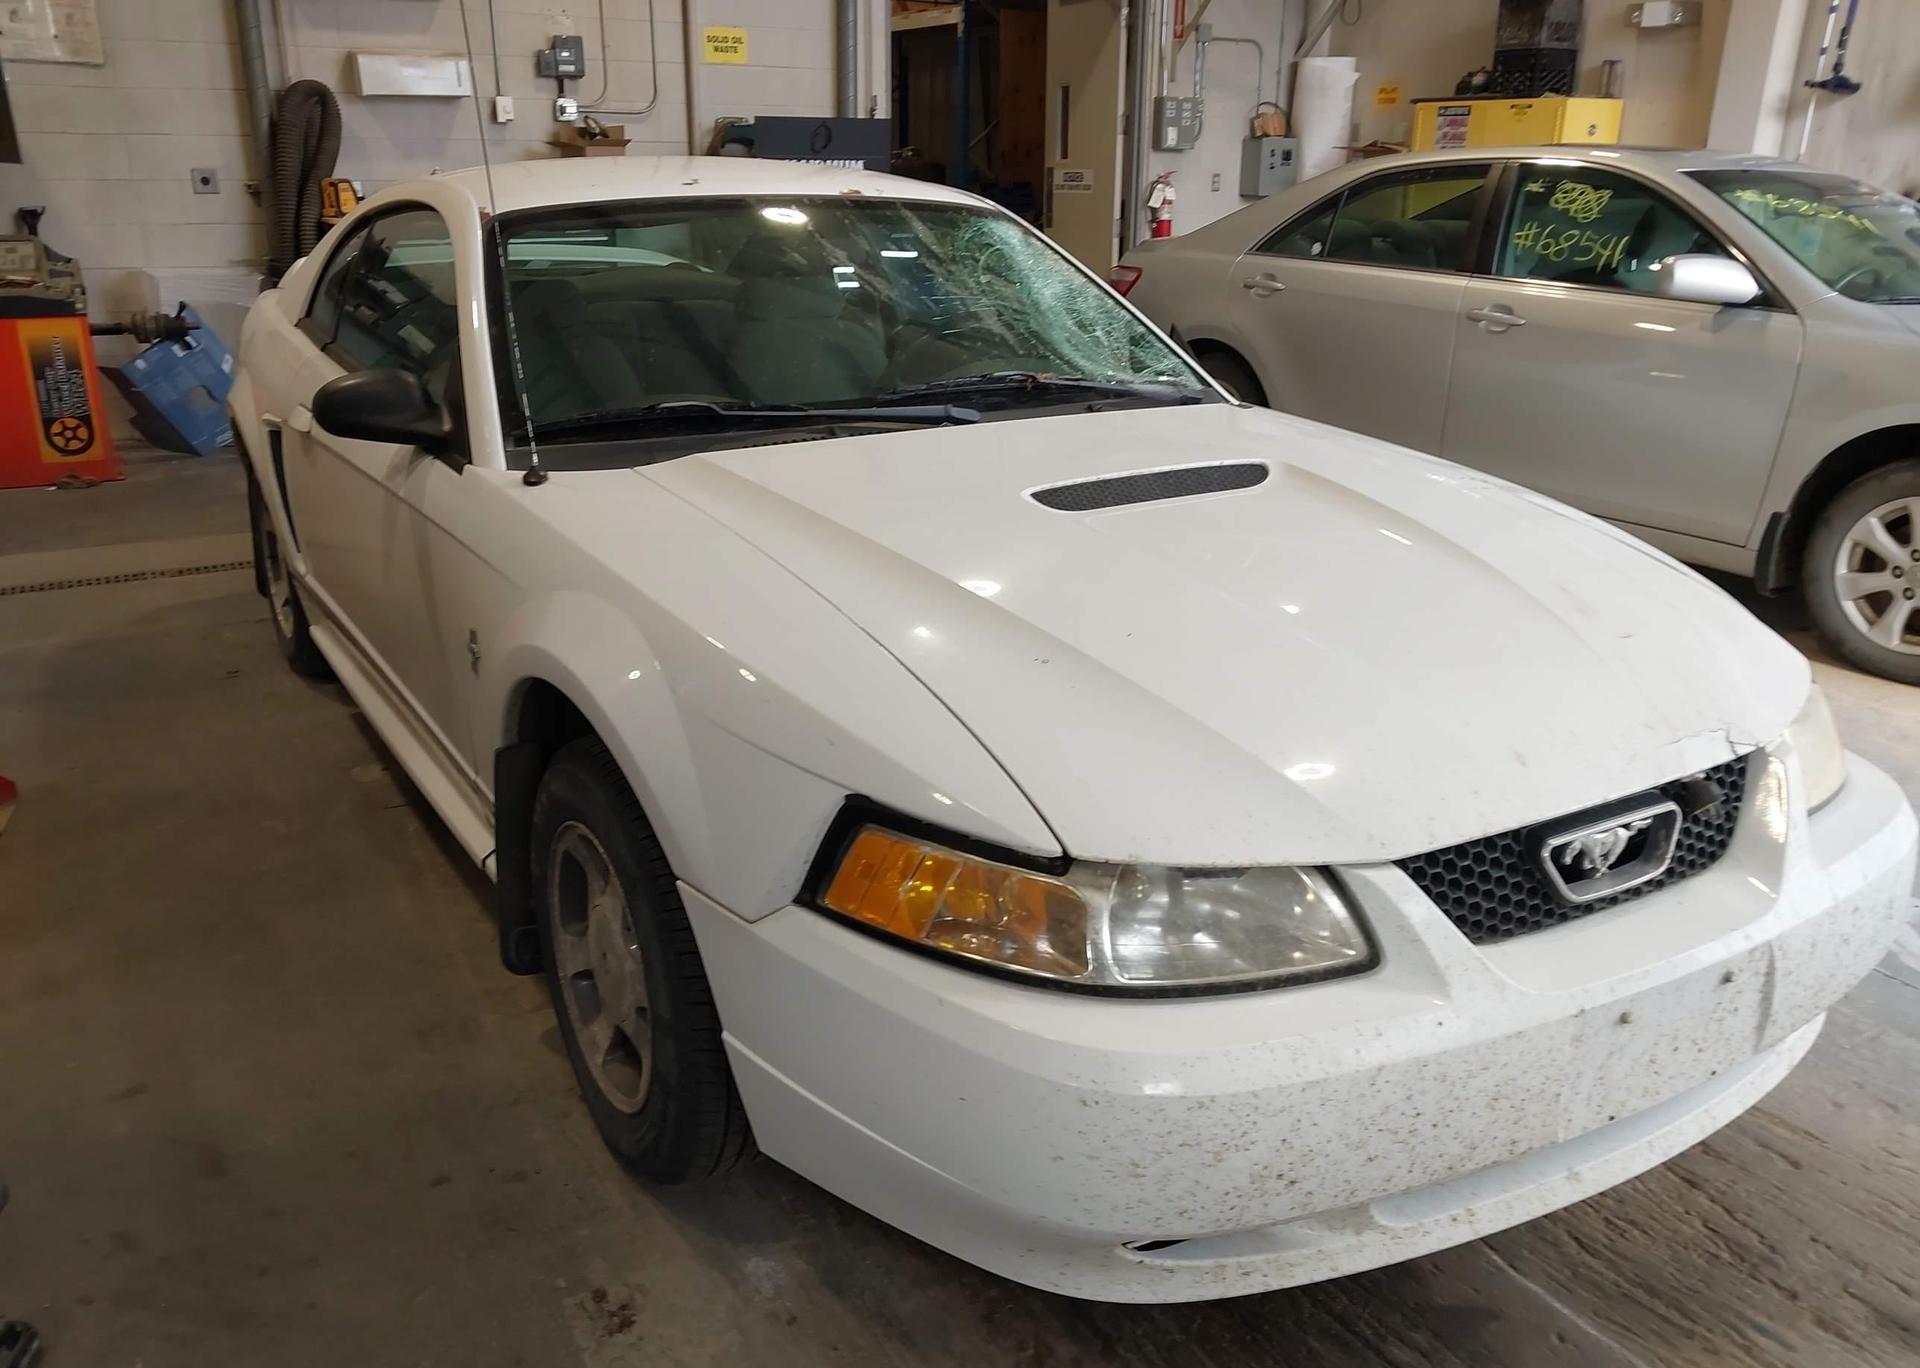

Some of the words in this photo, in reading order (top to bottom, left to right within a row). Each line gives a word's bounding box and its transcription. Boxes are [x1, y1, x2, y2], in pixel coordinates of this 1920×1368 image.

[706, 34, 729, 44] SOLID
[730, 36, 745, 45] OIL
[713, 45, 739, 54] WASTE
[1512, 220, 1630, 274] #68541
